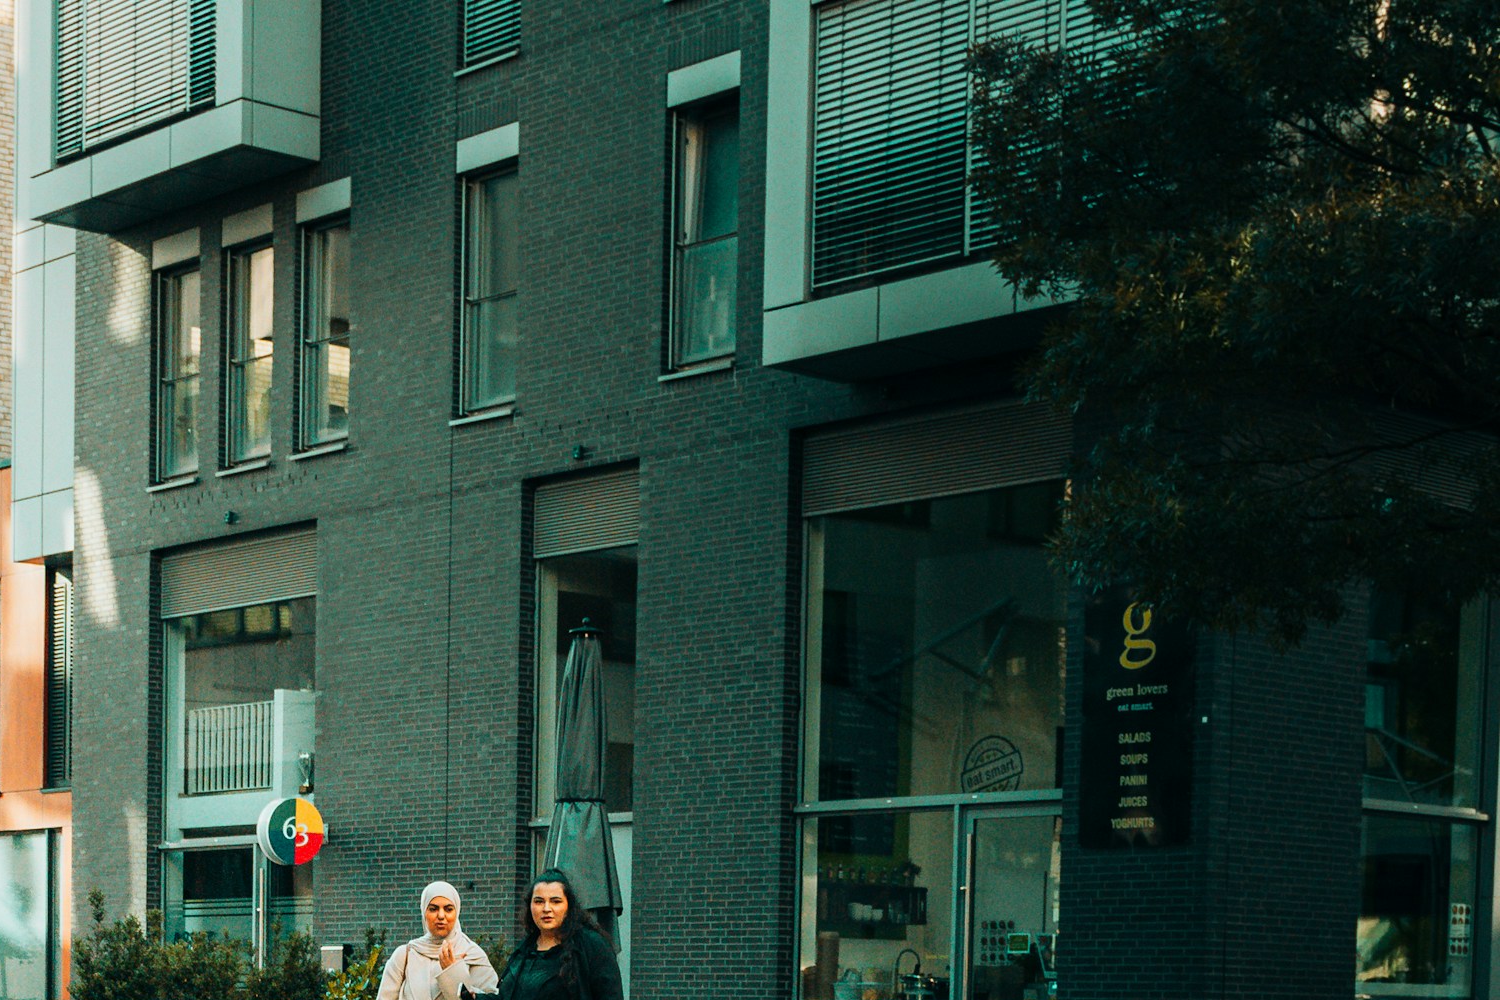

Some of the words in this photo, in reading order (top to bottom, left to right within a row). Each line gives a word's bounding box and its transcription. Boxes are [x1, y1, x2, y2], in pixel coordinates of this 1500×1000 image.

[1106, 686, 1134, 701] green
[1137, 683, 1169, 696] lovers
[1118, 731, 1151, 744] SALADS
[1120, 753, 1148, 765] SOUPS
[1119, 774, 1148, 786] PANINI
[1118, 795, 1148, 808] JUICES
[1111, 816, 1155, 829] YOGHURTS
[282, 816, 309, 847] 63
